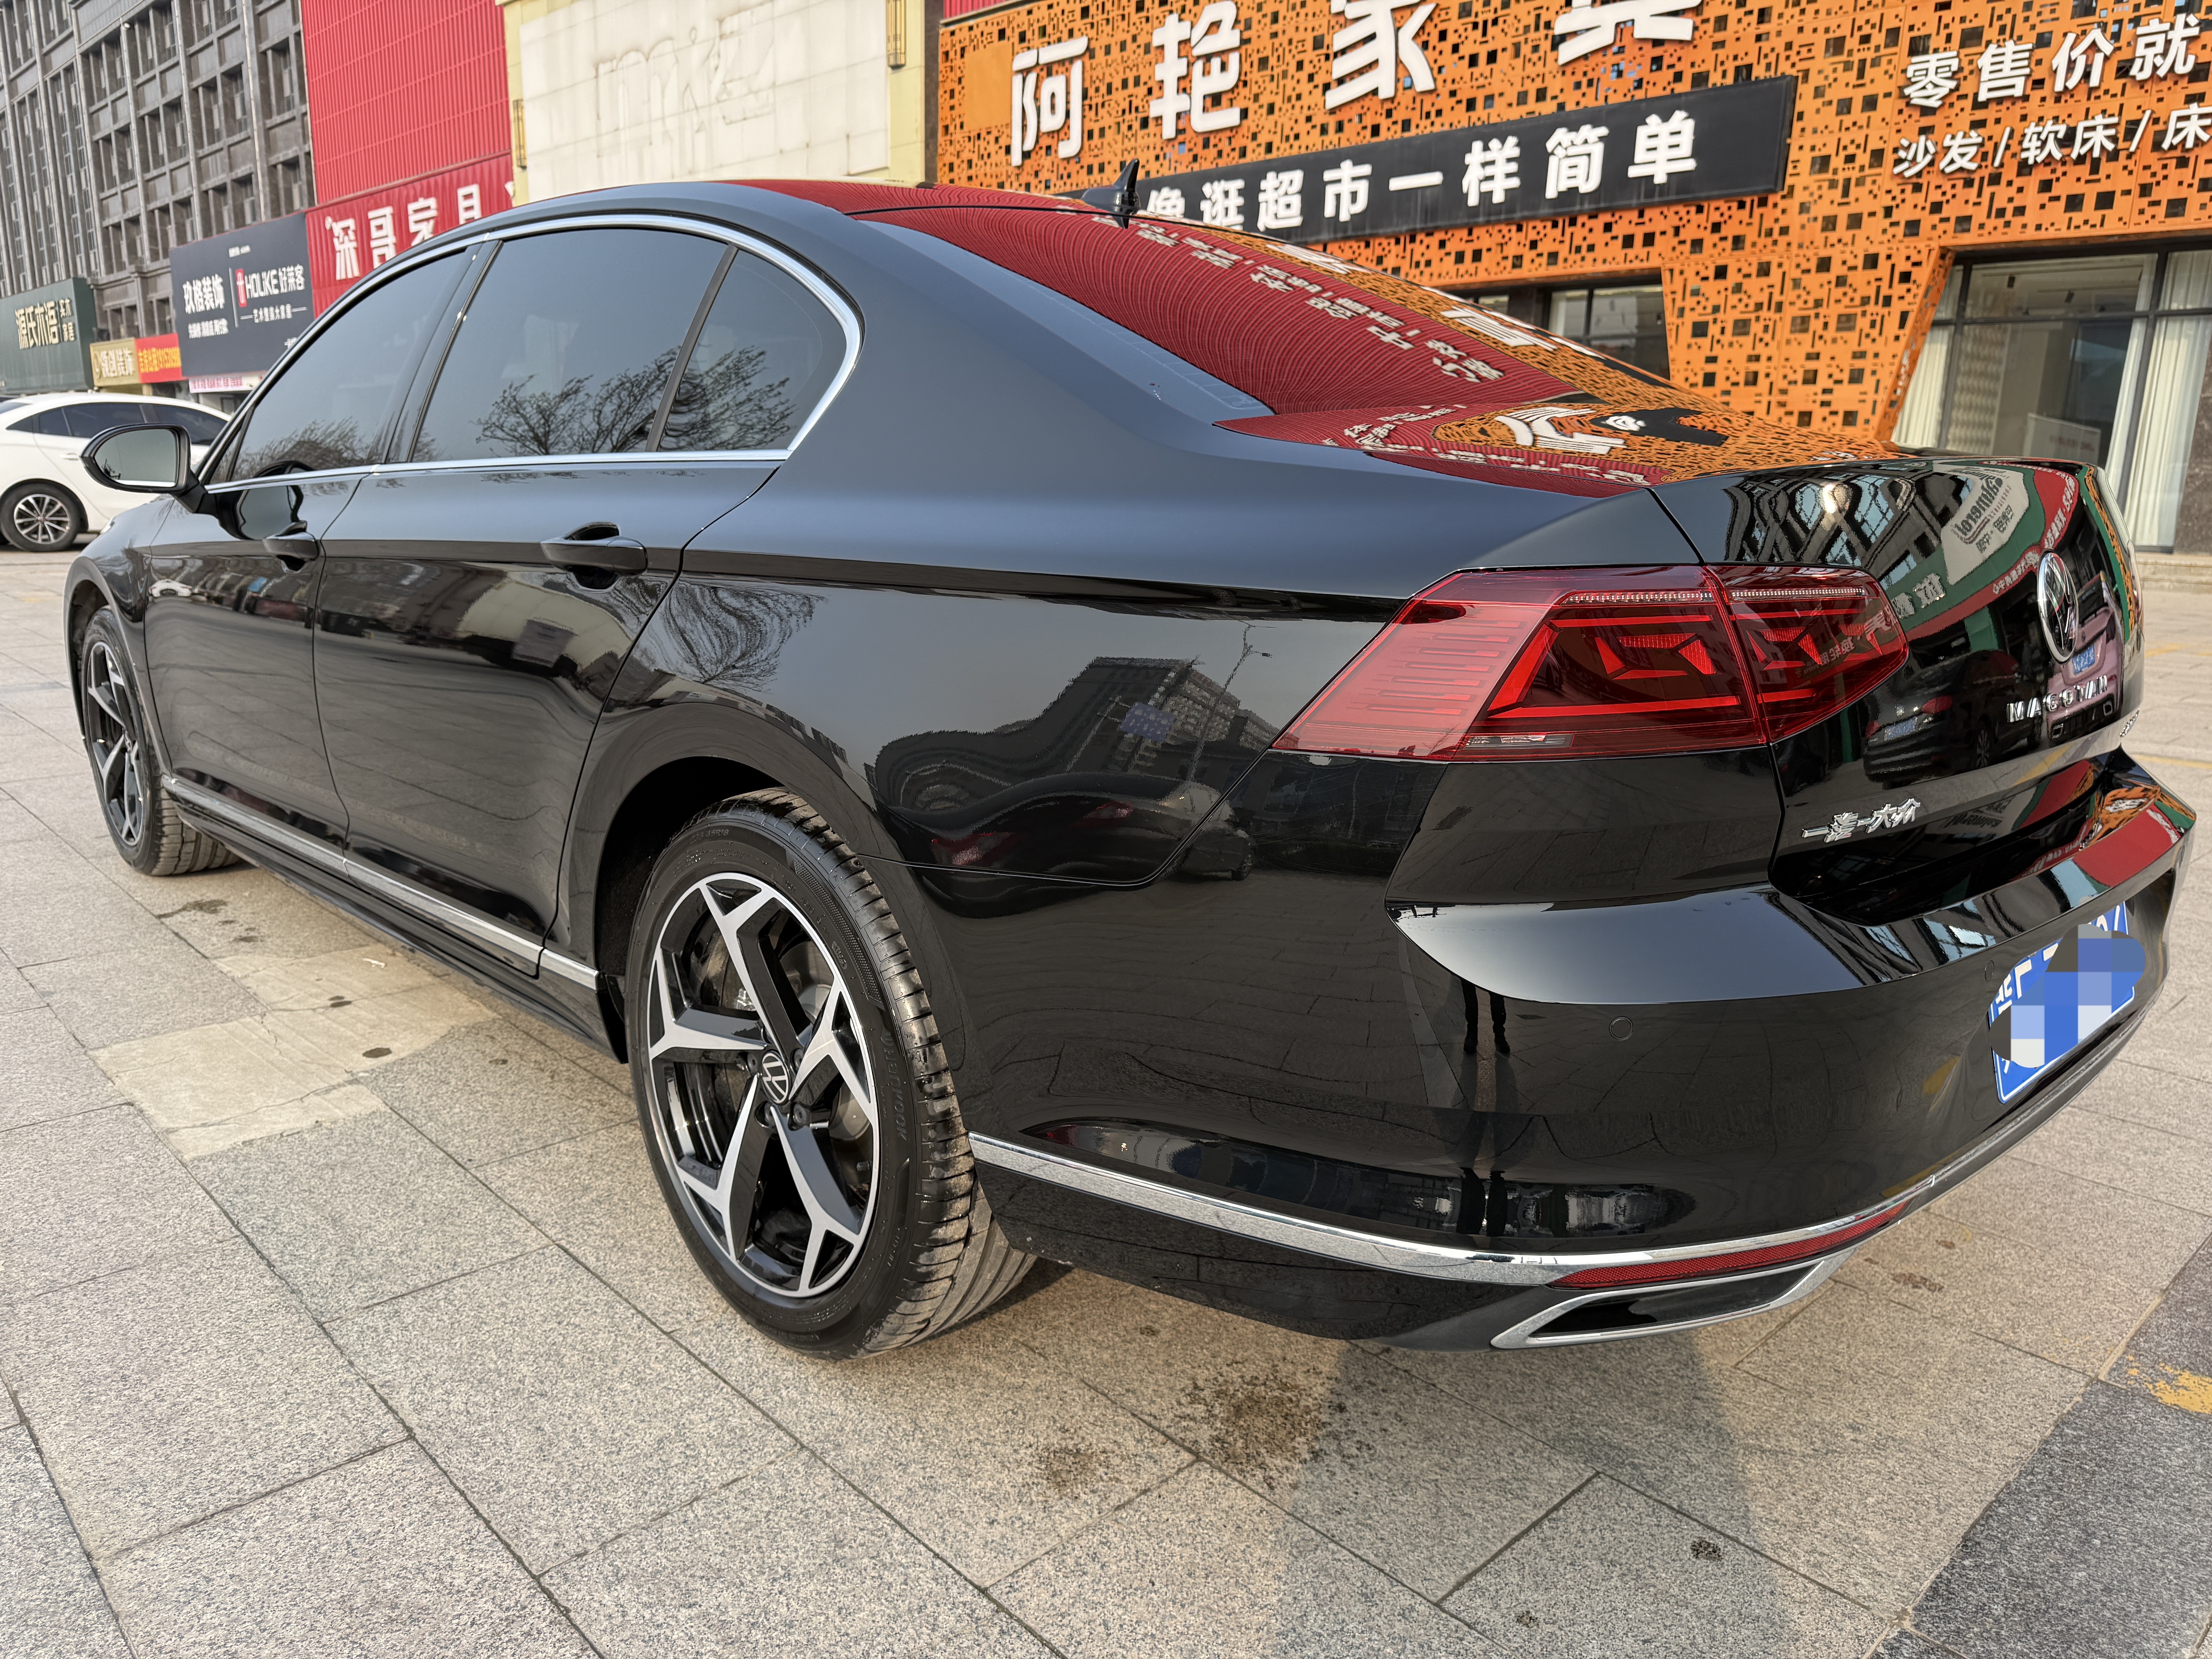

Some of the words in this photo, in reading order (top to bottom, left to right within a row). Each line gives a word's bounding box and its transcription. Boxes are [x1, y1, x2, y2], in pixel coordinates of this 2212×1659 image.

[1903, 13, 2200, 108] 零售价就
[1146, 109, 1697, 231] 像逛超市一样简单
[329, 181, 514, 280] 深哥家具
[15, 300, 59, 350] 源氏木语
[2006, 675, 2107, 723] MAGOTAN
